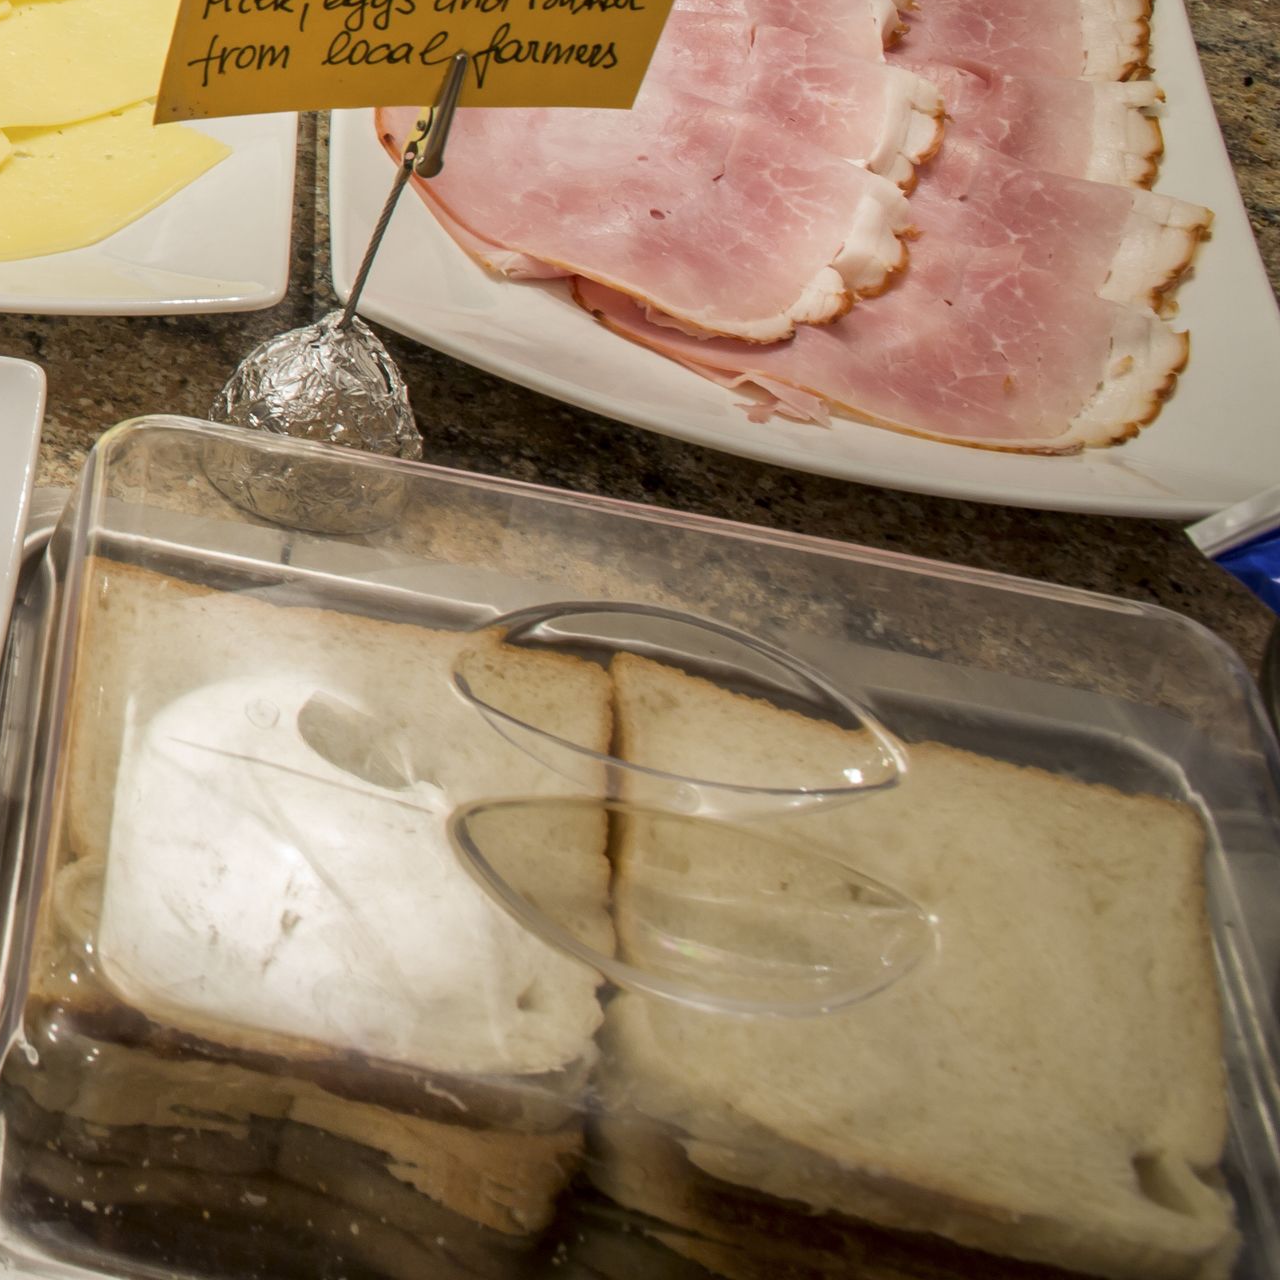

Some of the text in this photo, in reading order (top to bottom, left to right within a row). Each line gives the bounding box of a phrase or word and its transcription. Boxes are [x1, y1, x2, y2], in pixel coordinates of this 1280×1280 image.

[186, 21, 619, 90] from local farmers
